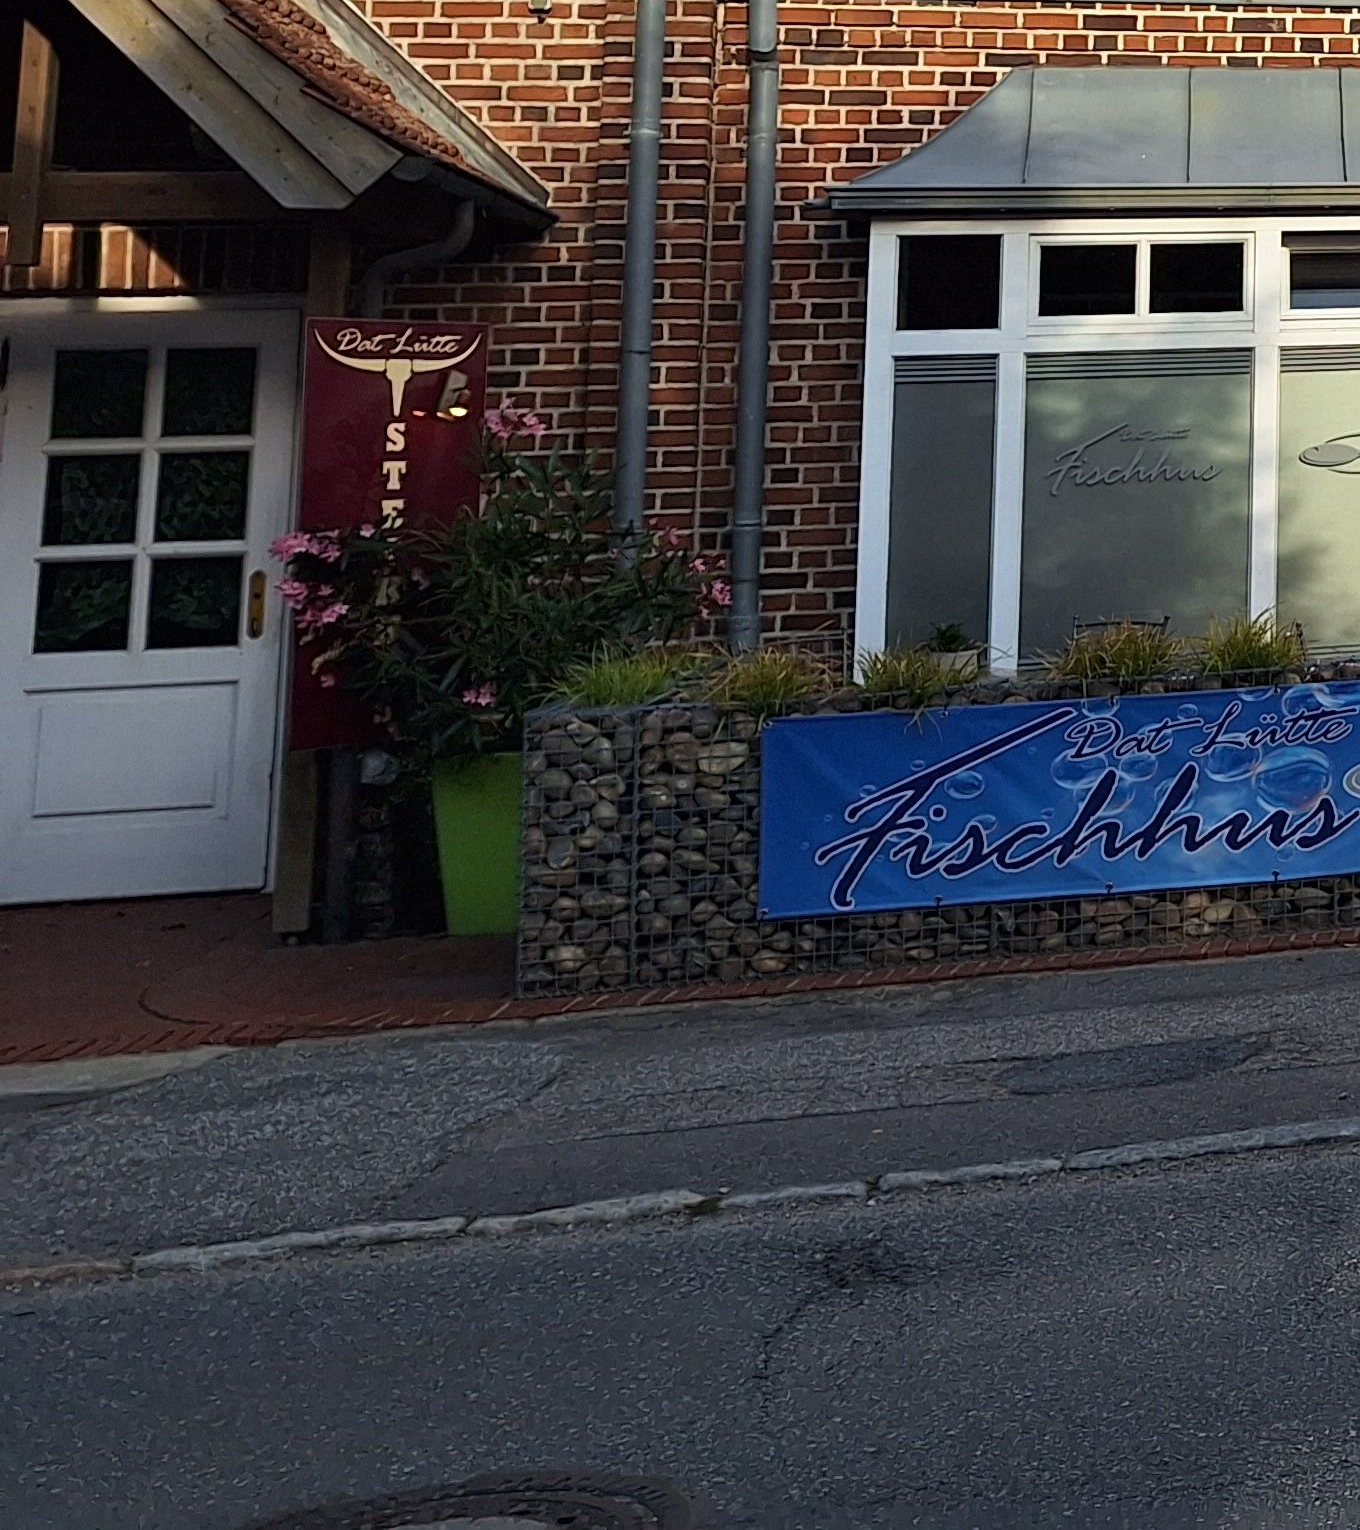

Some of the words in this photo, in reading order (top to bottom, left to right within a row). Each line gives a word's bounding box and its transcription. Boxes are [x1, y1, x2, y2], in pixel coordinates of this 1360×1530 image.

[337, 327, 396, 352] Dat
[389, 327, 463, 354] Lütte
[1045, 422, 1223, 496] Fischhus
[1064, 714, 1202, 760] Dat
[1192, 700, 1359, 756] Lütte
